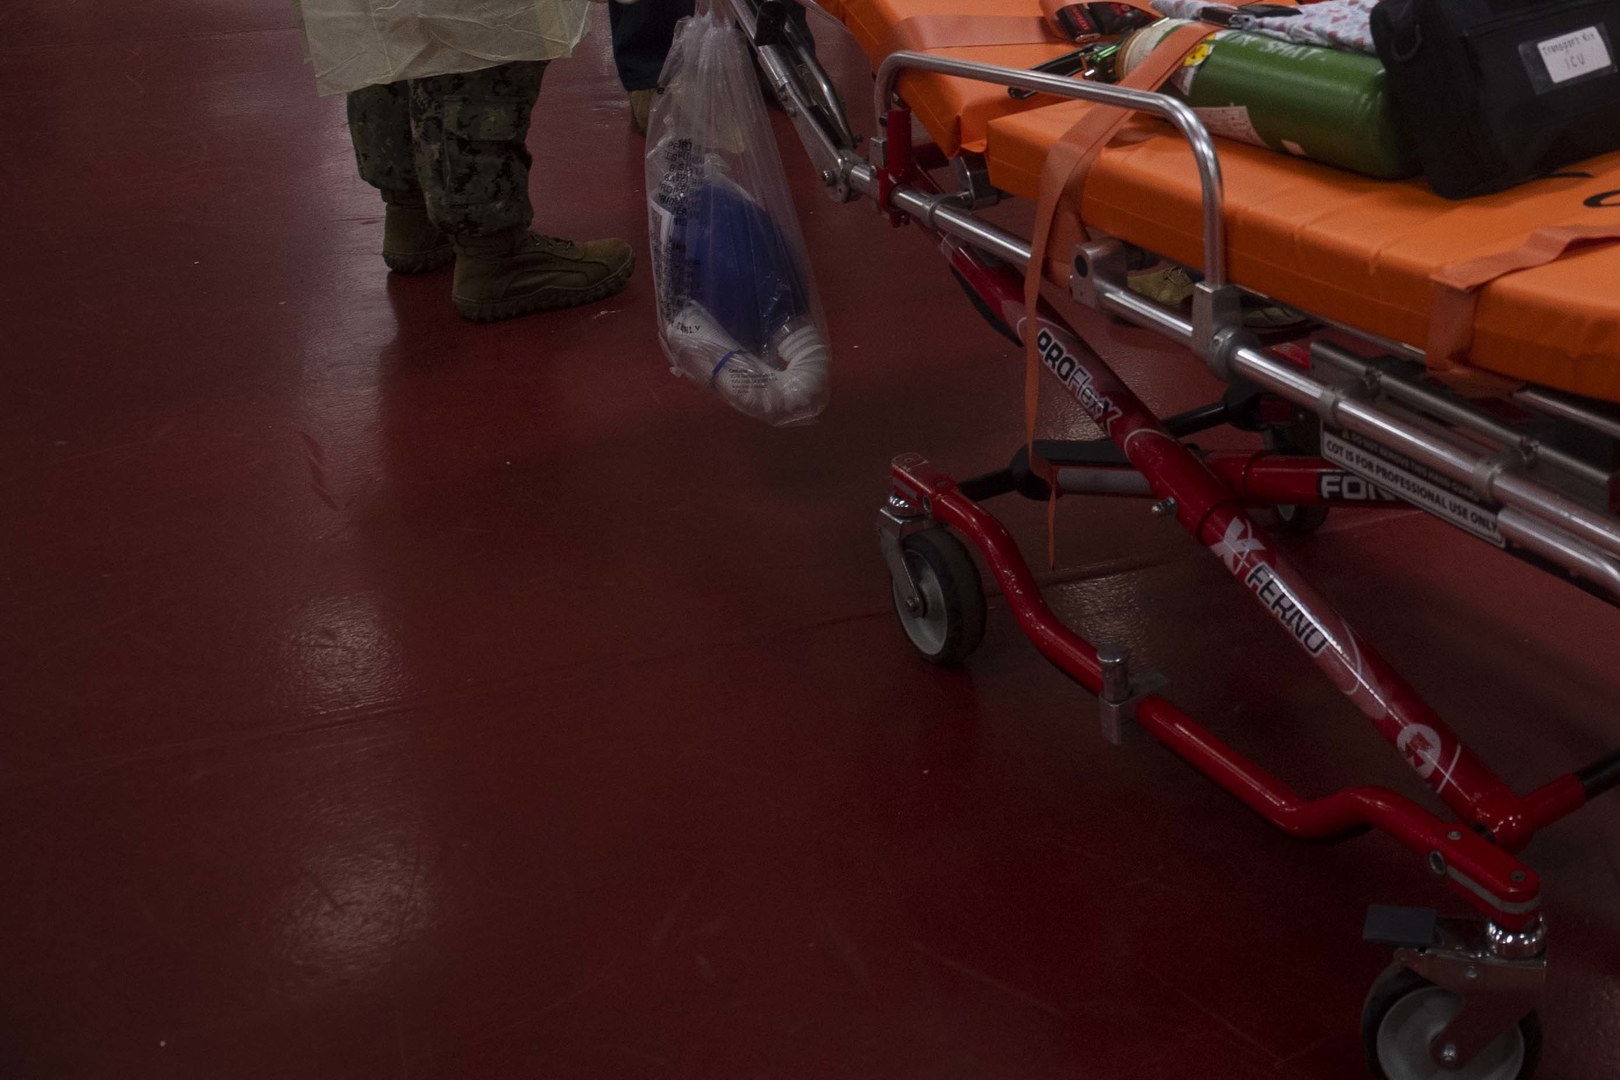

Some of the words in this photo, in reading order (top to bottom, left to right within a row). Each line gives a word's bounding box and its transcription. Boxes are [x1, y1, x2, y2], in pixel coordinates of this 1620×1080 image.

[1326, 440, 1345, 457] COT
[1345, 450, 1355, 462] IS
[1355, 454, 1373, 471] FOR
[1375, 464, 1447, 508] PROFESSIONAL
[1450, 502, 1468, 518] USE
[1470, 510, 1498, 532] ONLY
[1246, 561, 1335, 657] FERNO
